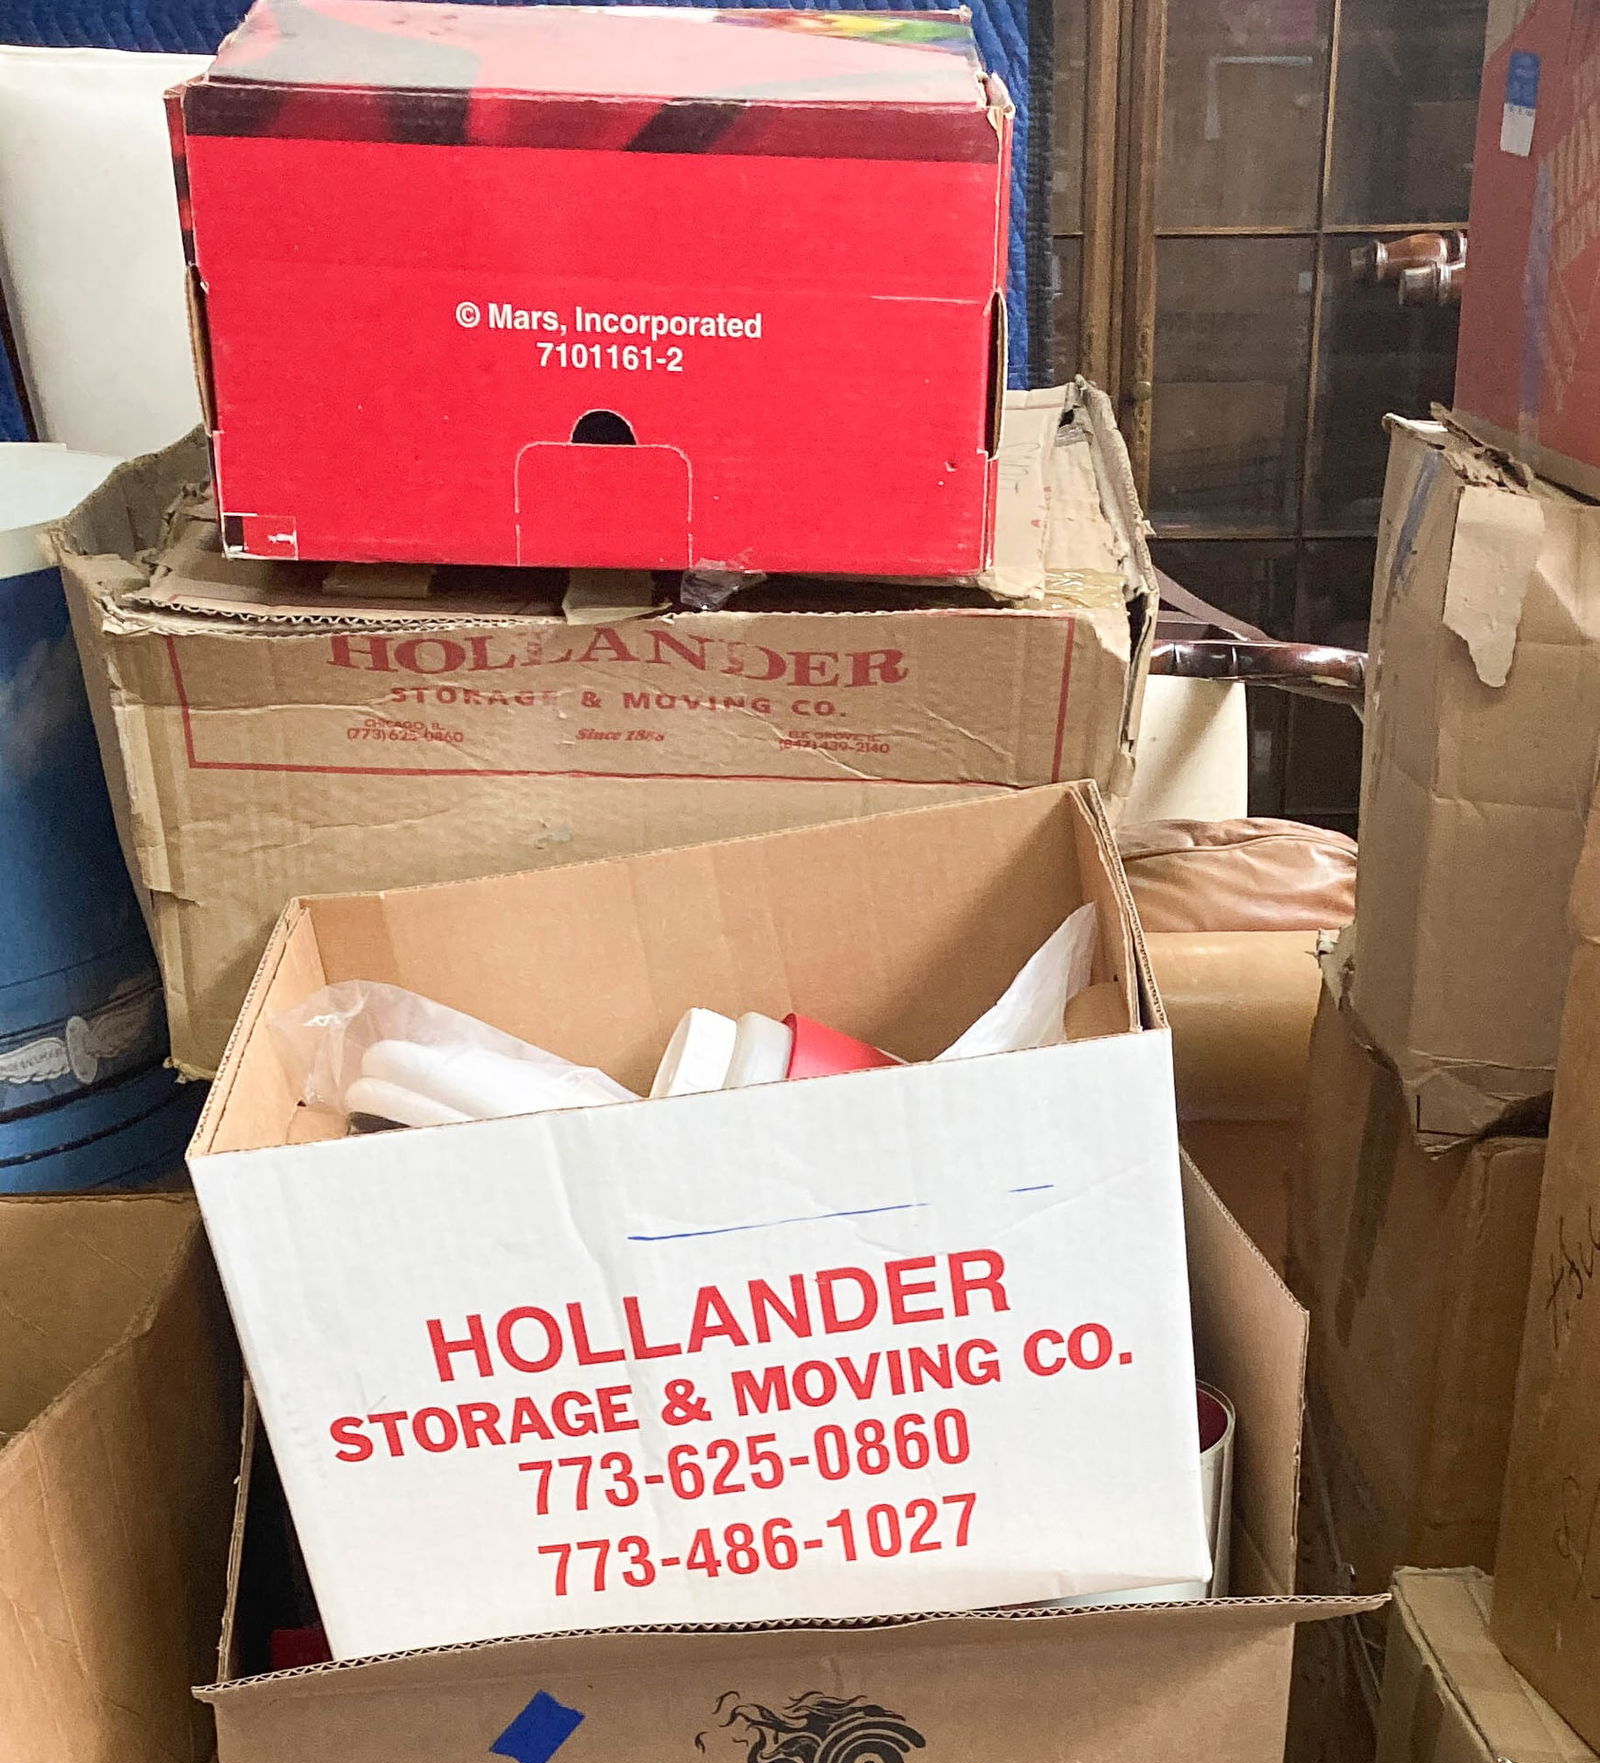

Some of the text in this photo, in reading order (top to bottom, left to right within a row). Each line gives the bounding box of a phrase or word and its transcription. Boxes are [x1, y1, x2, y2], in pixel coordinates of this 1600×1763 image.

[488, 303, 567, 335] Mars,
[575, 306, 762, 341] Incorporated
[536, 342, 684, 372] 7101161-2
[327, 627, 908, 688] HOLLANDER
[390, 687, 847, 717] STORAGE & MOVING CO.
[425, 1247, 1011, 1383] HOLLANDER
[329, 1323, 1134, 1465] STORAGE & MOVING CO.
[518, 1406, 972, 1516] 773-625-0860
[538, 1493, 978, 1597] 773-486-1027
